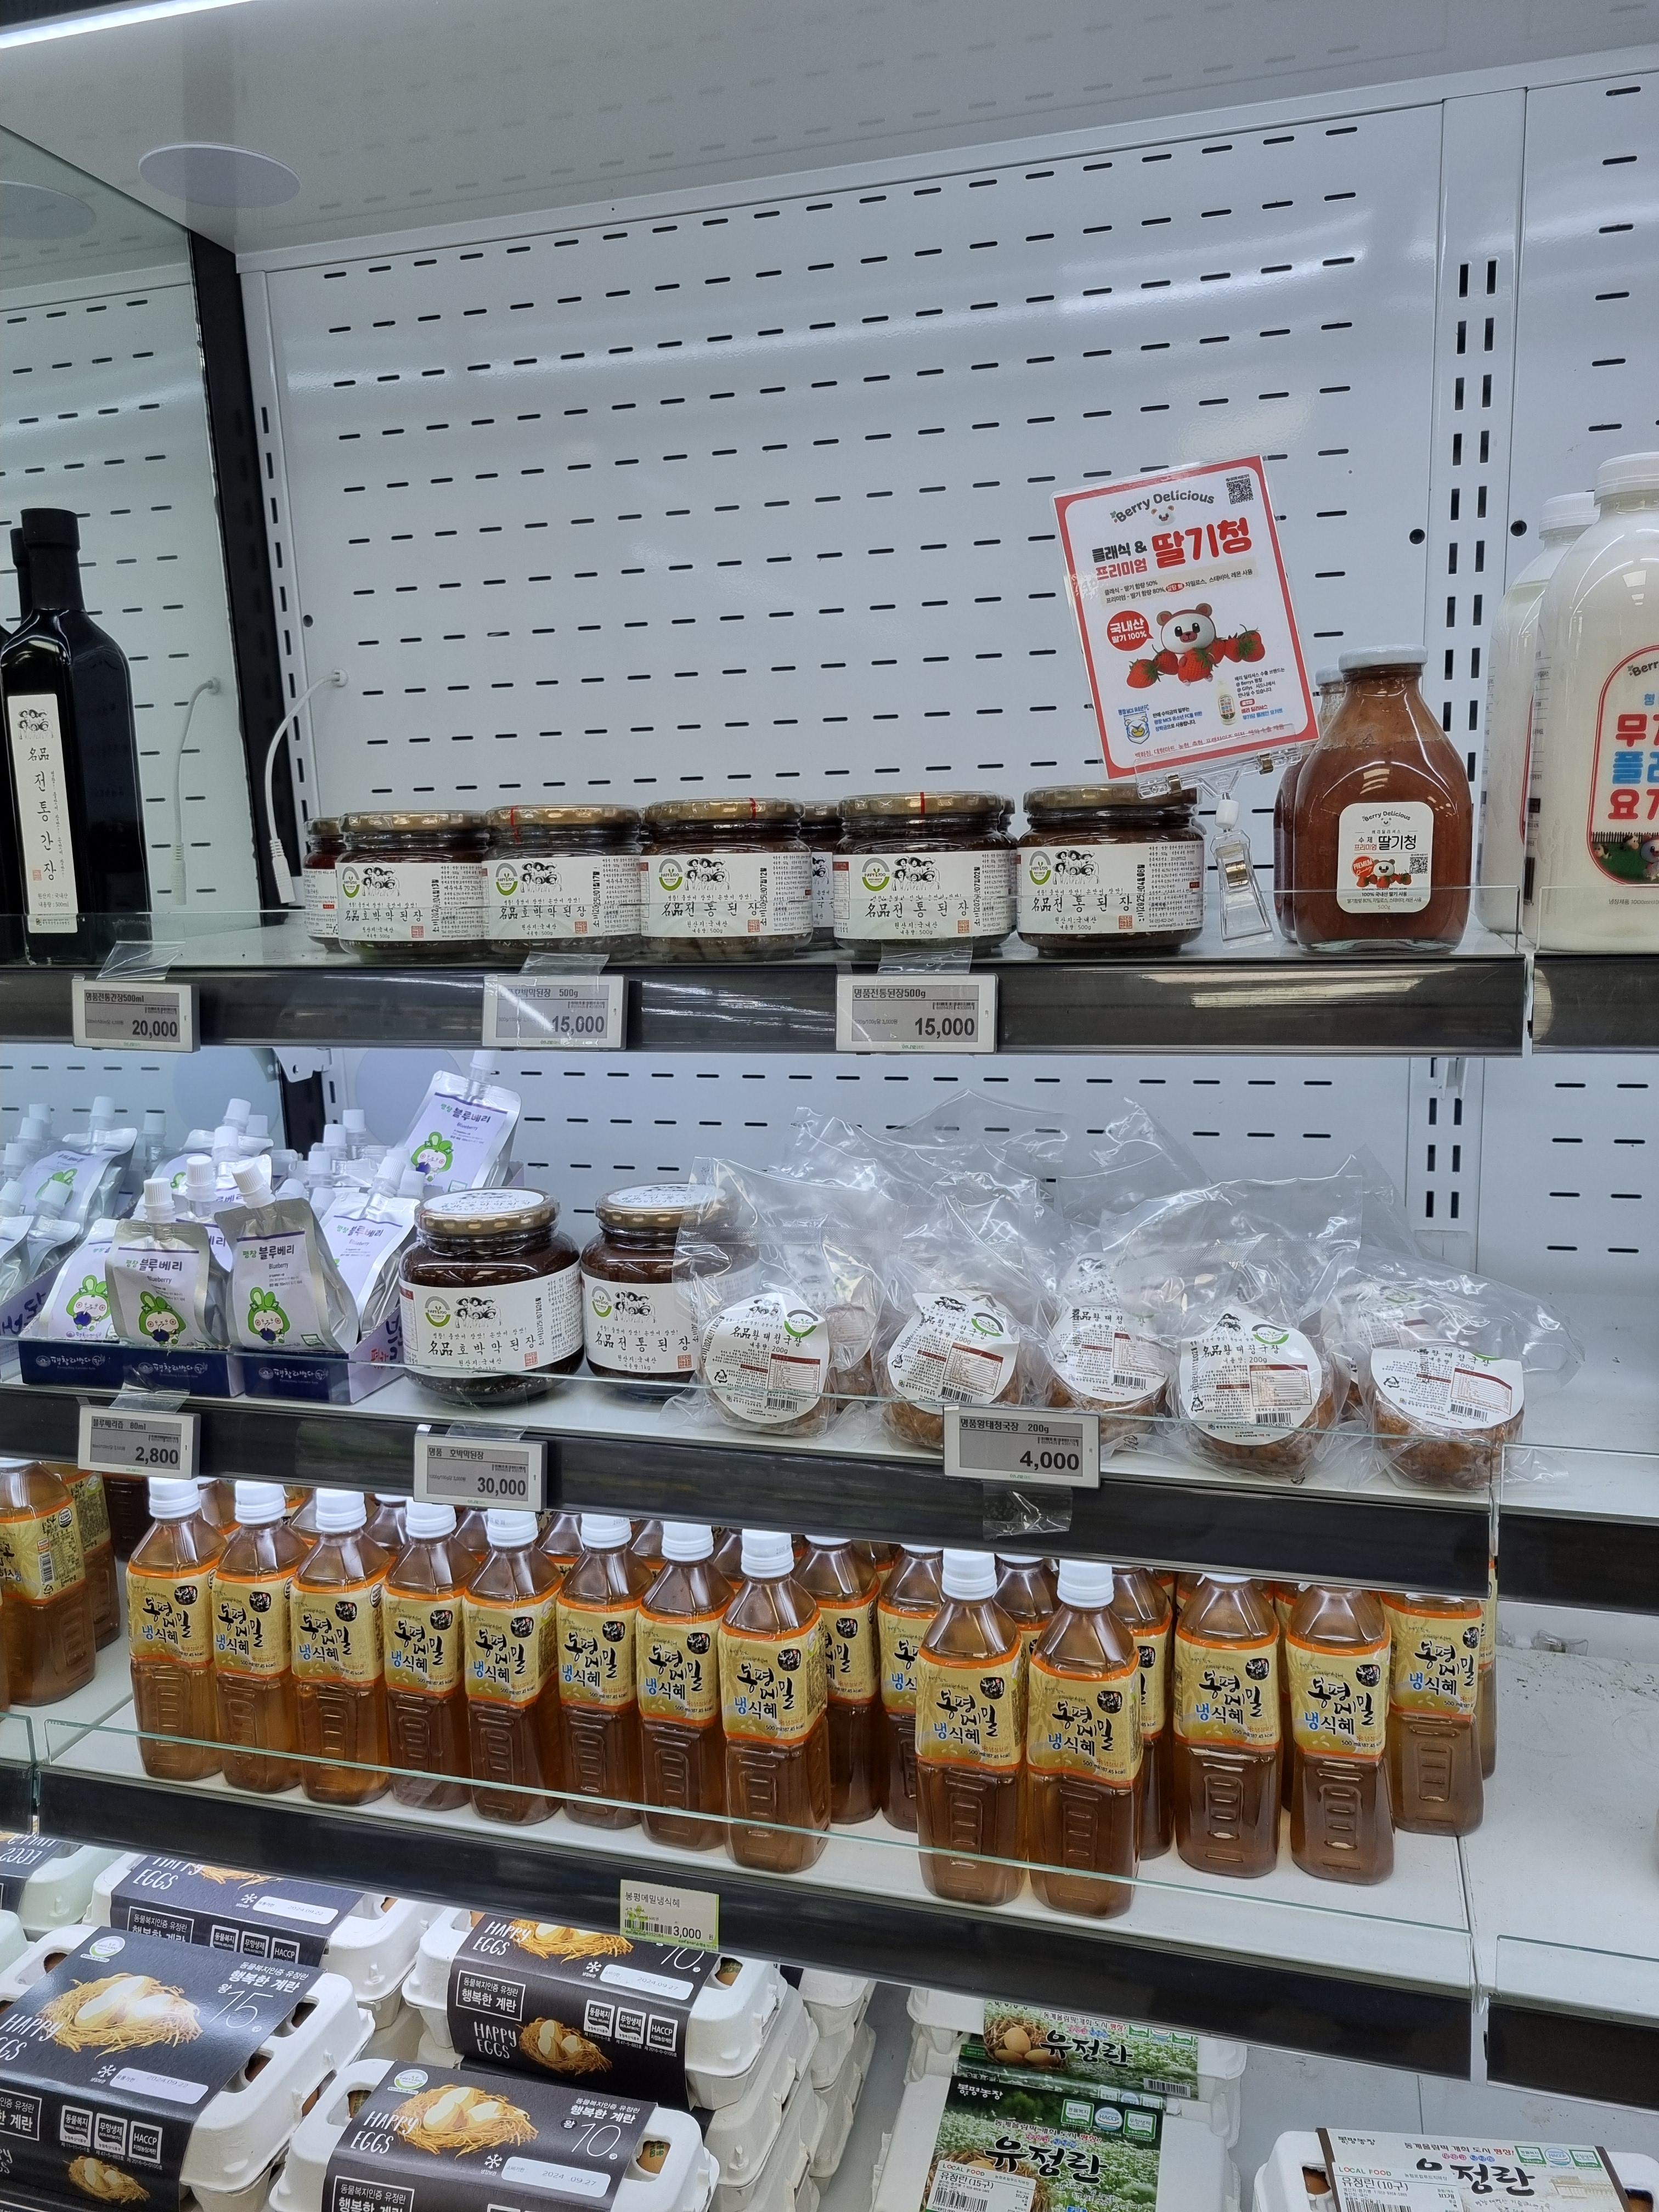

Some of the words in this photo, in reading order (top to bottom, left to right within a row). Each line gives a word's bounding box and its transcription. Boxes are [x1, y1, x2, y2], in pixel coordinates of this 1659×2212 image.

[1115, 499, 1150, 523] Berry
[1153, 490, 1214, 504] Delicious
[1092, 543, 1131, 563] 클래식
[1135, 541, 1147, 554] &
[1152, 517, 1252, 568] 딸기청
[1096, 558, 1147, 580] 프리미엄
[1124, 584, 1133, 592] 딸기
[1135, 582, 1145, 590] 함량
[1106, 595, 1126, 603] 프리미엄
[1130, 591, 1141, 600] 딸기
[1110, 618, 1144, 634] 국내산
[1111, 634, 1126, 644] 딸기
[1127, 631, 1147, 641] 100%
[1633, 661, 1659, 677] Berr
[28, 747, 49, 761] 名品
[1365, 812, 1381, 822] Berry
[1383, 811, 1410, 821] Delicious
[1379, 835, 1417, 850] 딸기청
[1353, 859, 1373, 870] PREMIUM
[662, 901, 683, 916] 名品
[685, 901, 759, 917] 전통된장
[865, 904, 890, 918] 名品
[893, 900, 969, 918] 전통된장
[1032, 898, 1051, 912] 名品
[1053, 895, 1132, 912] 전통된장
[345, 910, 359, 922] 名品
[362, 910, 424, 922] 호박막된장
[499, 906, 518, 919] 名品
[521, 906, 586, 919] 호박막된장
[559, 989, 578, 998] 500g
[854, 989, 926, 999] 명품전통된장500g
[132, 1020, 178, 1038] 20,000
[552, 1015, 605, 1035] 15,000
[915, 1018, 975, 1039] 15,000
[453, 1108, 491, 1123] 블루베리
[457, 1122, 478, 1131] Blueberry
[349, 1225, 384, 1238] 블루베리
[242, 1250, 257, 1259] 평창
[258, 1245, 294, 1260] 블루베리
[139, 1259, 183, 1272] 블루베리
[269, 1261, 289, 1270] Blueberry
[730, 1326, 751, 1339] 名品
[955, 1335, 971, 1345] 200g
[428, 1340, 453, 1357] 名品
[457, 1335, 537, 1356] 호박막된장
[595, 1331, 614, 1348] 名品
[618, 1335, 691, 1352] 전통된장
[772, 1346, 788, 1354] 200g
[1223, 1344, 1280, 1355] 황태청국장
[1456, 1362, 1475, 1370] 200g
[93, 1419, 124, 1429] 블루베리즙
[961, 1418, 1019, 1431] 명품황태청국장
[1028, 1423, 1049, 1434] 200g
[136, 1446, 179, 1465] 2,800
[428, 1447, 442, 1457] 명품
[450, 1449, 484, 1460] 호박막된장
[1019, 1451, 1079, 1470] 4,000
[477, 1477, 526, 1496] 30,000
[143, 1597, 173, 1623] 봉평
[163, 1610, 192, 1639] 메밀
[300, 1614, 332, 1640] 봉평
[322, 1626, 352, 1656] 메밀
[475, 1628, 507, 1657] 봉평
[495, 1644, 526, 1674] 메밀
[736, 1662, 774, 1693] 봉평
[760, 1677, 795, 1711] 메밀
[1308, 1678, 1351, 1708] 봉평
[936, 1690, 976, 1720] 봉평
[1334, 1693, 1375, 1726] 메밀
[960, 1704, 998, 1737] 메밀
[1052, 1701, 1092, 1730] 봉평
[1077, 1718, 1114, 1751] 메밀
[133, 1869, 178, 1890] EGGS
[133, 1914, 168, 1929] 동물복지인증
[169, 1922, 187, 1932] 유정란
[484, 1921, 532, 1942] HAPPY
[215, 1932, 235, 1944] 동물복지
[674, 1926, 701, 1939] 3,000
[244, 1938, 265, 1950] 무항생제
[275, 1947, 295, 1958] HACCP
[473, 1937, 510, 1956] EGGS
[240, 1962, 285, 1976] 동물복지인증
[285, 1971, 309, 1980] 유정란
[218, 1983, 233, 1994] 왕
[229, 1970, 270, 1987] 행복한
[270, 1979, 301, 1993] 계란
[464, 1977, 499, 1993] 동물복지인증
[500, 1986, 518, 1997] 유정란
[637, 1977, 679, 1990] 2024.09.27
[209, 1991, 273, 2028] 15
[462, 1989, 492, 2007] 행복한
[496, 1997, 517, 2013] 계란
[589, 2007, 611, 2019] 동물복지
[620, 2015, 641, 2026] 무항생제
[1, 2013, 64, 2041] HAPPY
[474, 2021, 517, 2047] HAPPY
[651, 2025, 673, 2036] HACCP
[0, 2036, 27, 2062] GGS
[477, 2039, 510, 2059] EGGS
[1039, 2029, 1133, 2069] 유정란
[14, 2099, 35, 2114] 유정란
[576, 2098, 617, 2109] 동물복지인증
[66, 2114, 88, 2128] 동물복지
[363, 2110, 420, 2136] HAPPY
[571, 2105, 607, 2119] 행복한
[610, 2112, 636, 2124] 계란
[10, 2115, 33, 2132] 계란
[99, 2122, 123, 2136] 무항생제
[133, 2133, 157, 2146] HACCP
[350, 2131, 395, 2155] EGGS
[564, 2120, 575, 2129] 왕
[571, 2123, 621, 2157] 10
[943, 2164, 963, 2172] LOCAL
[984, 2136, 1109, 2185] 유정란
[541, 2170, 565, 2180] 2024
[941, 2172, 967, 2184] 유정란
[969, 2179, 994, 2189] (15구)
[1342, 2177, 1374, 2189] 유정란
[1378, 2180, 1408, 2192] (10구)
[340, 2183, 383, 2201] 동물복지인증
[384, 2192, 407, 2205] 유정란
